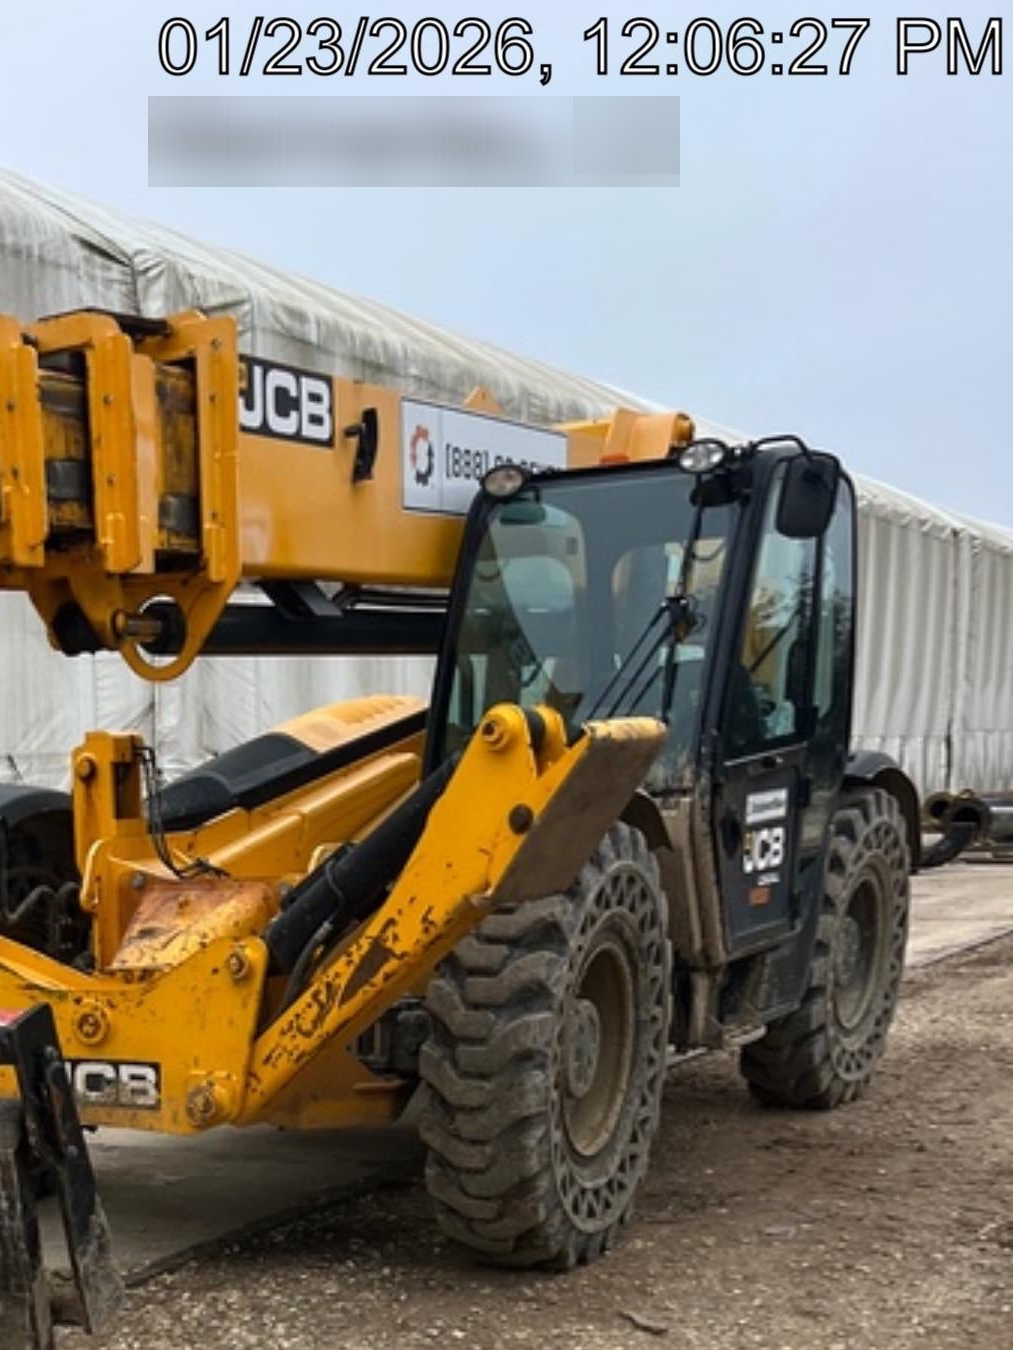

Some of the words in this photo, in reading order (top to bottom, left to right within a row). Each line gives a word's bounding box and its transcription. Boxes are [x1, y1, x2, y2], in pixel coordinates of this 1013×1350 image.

[239, 364, 332, 441] JCB
[743, 827, 784, 873] JCB
[65, 1062, 158, 1105] CB
